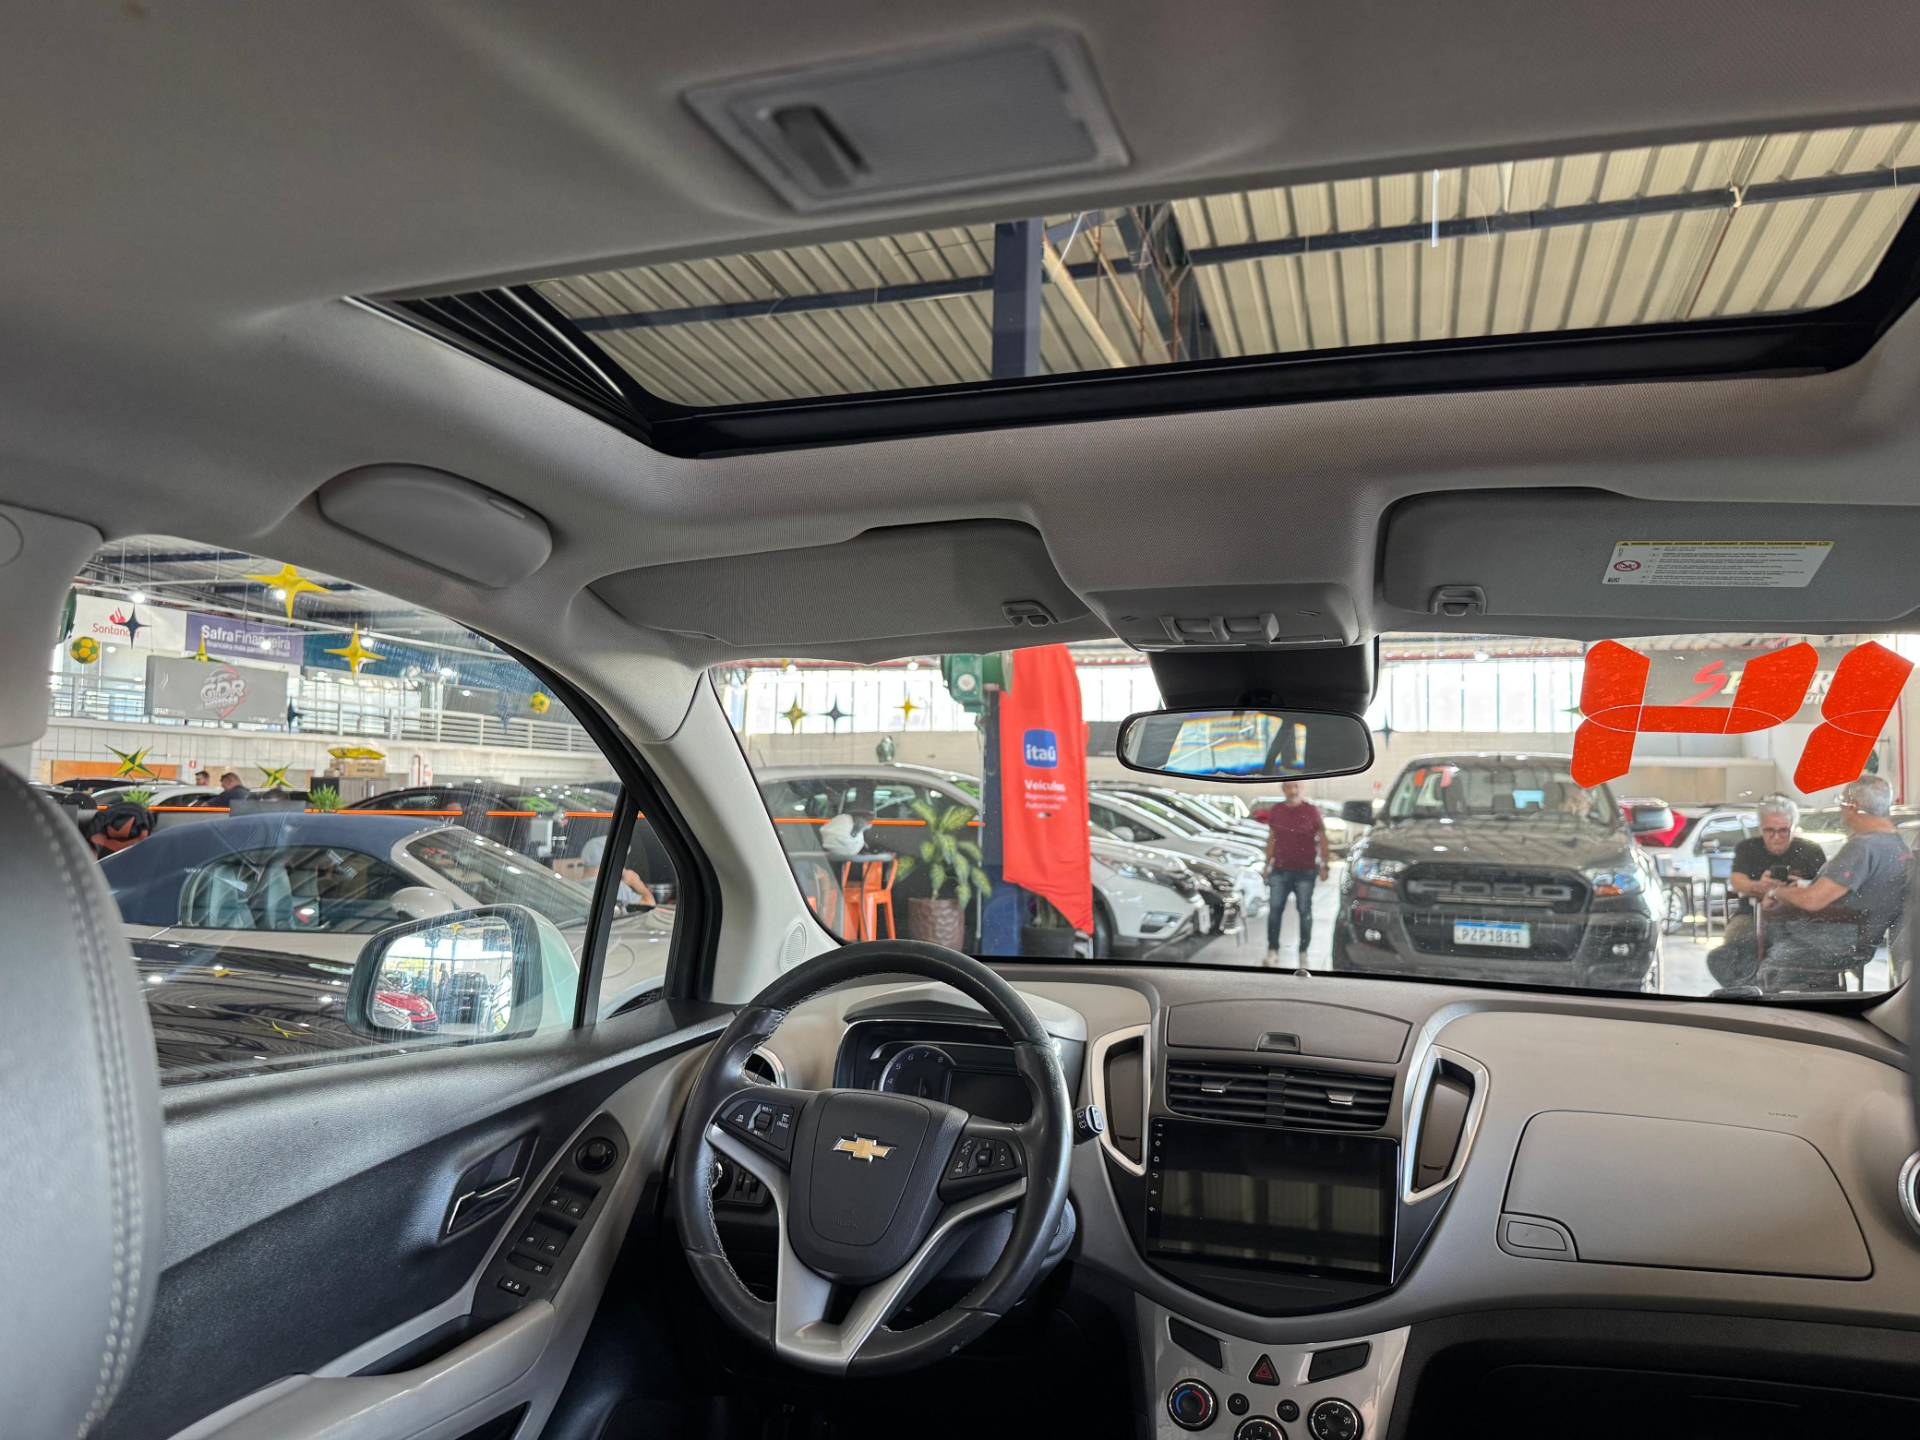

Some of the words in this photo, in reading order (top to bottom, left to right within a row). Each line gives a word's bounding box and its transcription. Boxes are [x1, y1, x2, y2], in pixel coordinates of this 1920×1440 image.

[93, 622, 142, 639] Santanr
[200, 679, 245, 702] GDR
[1026, 744, 1056, 761] itaú
[1407, 880, 1573, 901] FORD
